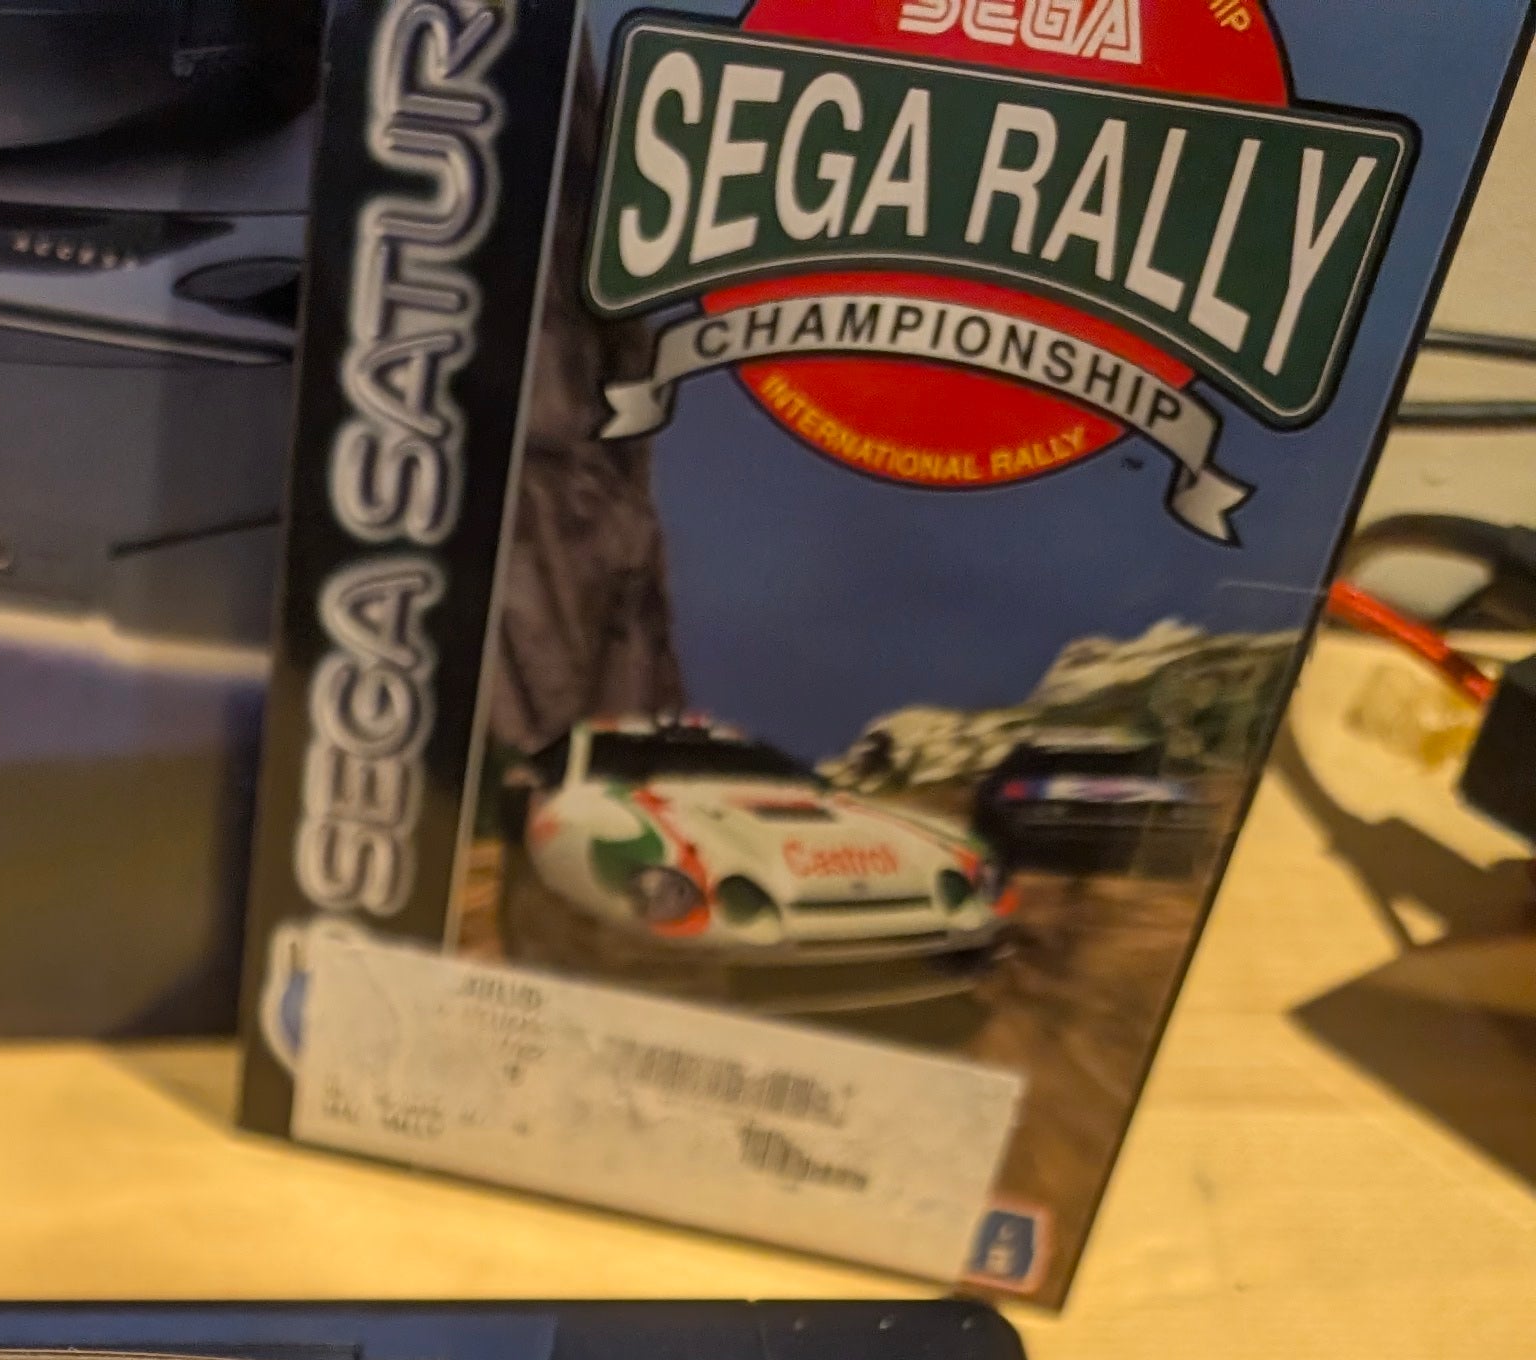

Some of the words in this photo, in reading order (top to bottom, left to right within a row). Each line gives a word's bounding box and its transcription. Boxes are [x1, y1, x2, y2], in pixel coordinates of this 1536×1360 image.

[618, 51, 931, 279] SEGA
[965, 101, 1378, 377] RALLY
[693, 302, 1184, 431] CHAMPIONSHIP
[760, 370, 984, 482] INTERNATIONAL
[989, 425, 1087, 478] RALLY
[296, 556, 446, 916] SEGA
